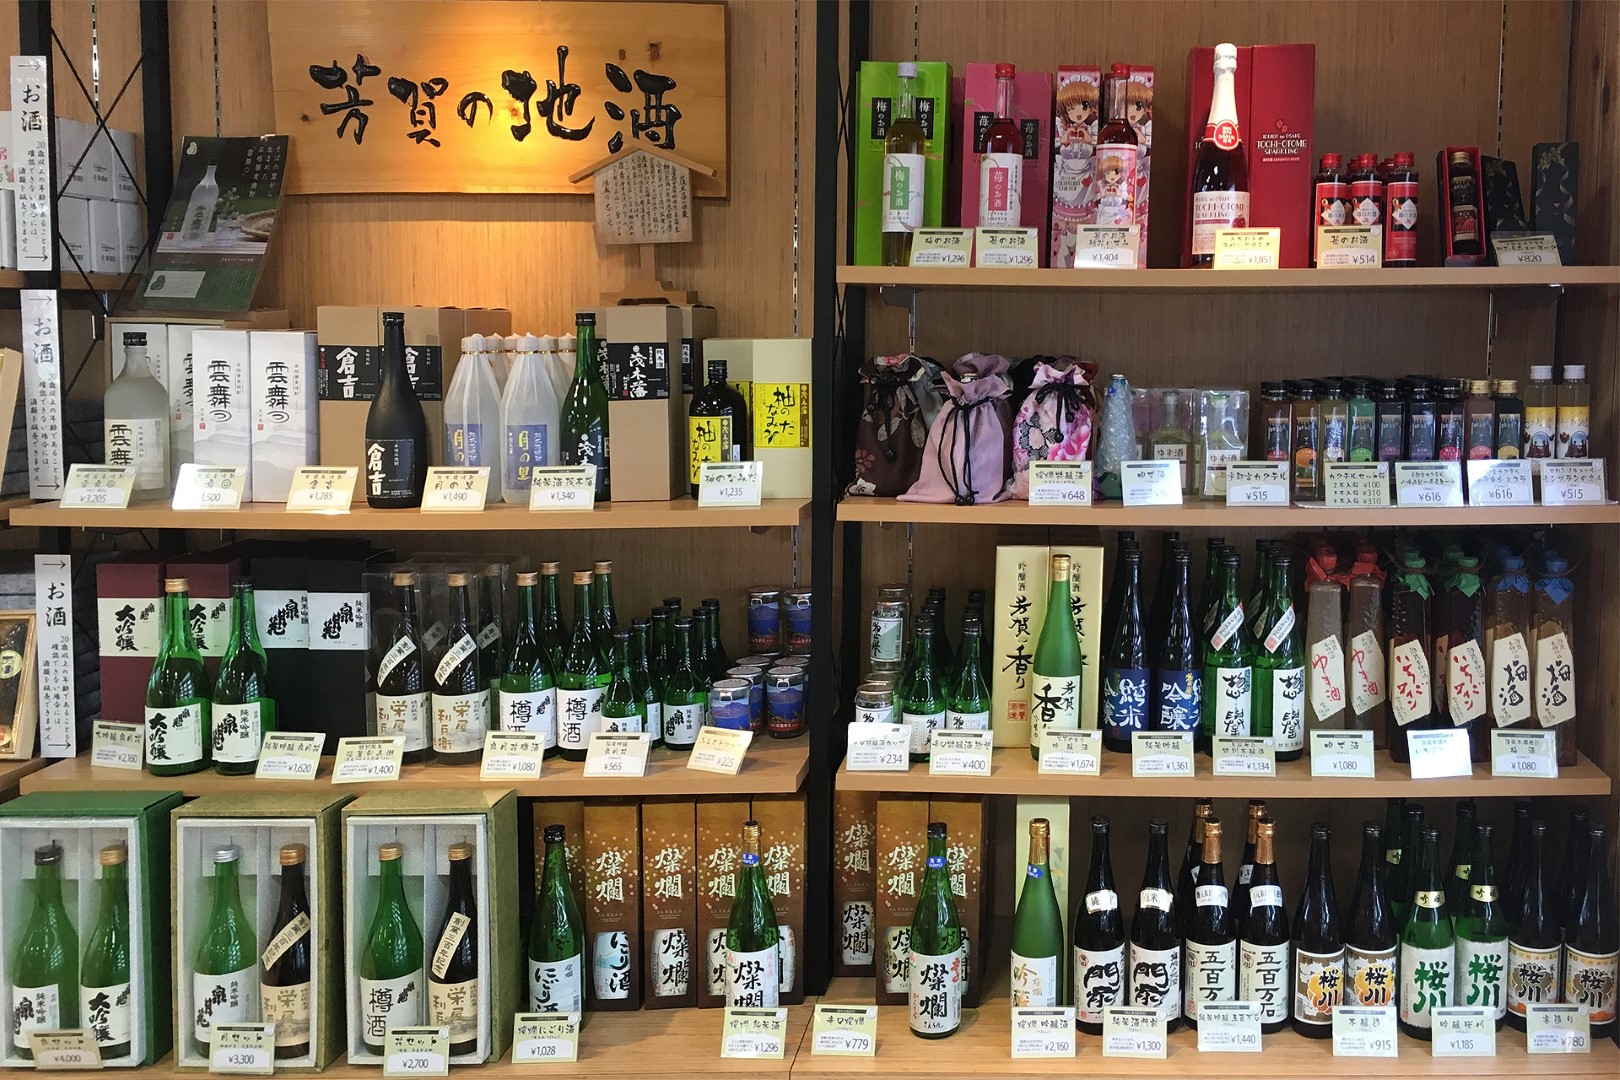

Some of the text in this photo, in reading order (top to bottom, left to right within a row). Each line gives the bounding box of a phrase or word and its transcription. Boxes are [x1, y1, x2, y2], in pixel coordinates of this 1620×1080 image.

[22, 84, 42, 132] お酒
[309, 45, 682, 155] 芳賀の地酒
[876, 99, 888, 136] 梅のお酒
[1024, 122, 1035, 157] 苺のお酒
[1256, 139, 1308, 149] TOCHI-OTOME
[894, 169, 906, 207] 梅のお酒
[993, 171, 1004, 207] 苺のお酒
[942, 254, 965, 263] ¥1,296
[1009, 255, 1034, 265] ¥1,296
[1092, 253, 1119, 262] ¥1,404
[1248, 254, 1273, 263] ¥1,851
[1352, 255, 1376, 264] ¥514
[1517, 255, 1542, 263] ¥820
[33, 318, 54, 364] お酒
[335, 346, 359, 399] 倉吉
[629, 351, 649, 399] 茂木藩
[1157, 448, 1185, 458] ゆず酒
[367, 442, 386, 496] 倉吉
[79, 494, 107, 504] ¥3,205
[308, 491, 333, 501] ¥1,285
[443, 491, 468, 501] ¥1,490
[551, 492, 575, 501] ¥1,340
[719, 486, 743, 497] ¥1,235
[1061, 490, 1085, 500] ¥648
[1245, 490, 1268, 501] ¥515
[1363, 481, 1381, 489] ¥100
[1418, 492, 1442, 502] ¥616
[1488, 488, 1513, 500] ¥616
[1560, 488, 1584, 499] ¥515
[1362, 497, 1381, 505] ¥310
[1017, 562, 1027, 592] 吟醸酒
[46, 582, 67, 627] お酒
[300, 595, 309, 625] 純米吟醸
[355, 599, 364, 629] 純米吟醸
[115, 604, 139, 652] 大吟醸
[1002, 596, 1033, 690] 芳賀の香り
[1312, 654, 1342, 702] ゆず酒
[1350, 648, 1379, 697] ゆず酒
[1498, 660, 1528, 707] 梅酒
[1542, 659, 1572, 707] 梅酒
[390, 700, 408, 732] 栄屋
[452, 700, 471, 733] 栄屋
[1116, 678, 1147, 730] 純米
[1160, 682, 1193, 730] 吟醸
[239, 708, 250, 739] 純米吟醸
[437, 708, 452, 751] 利兵衛
[562, 697, 589, 743] 樽酒
[149, 712, 172, 761] 大吟醸
[117, 753, 138, 764] ¥2,160
[288, 762, 312, 773] ¥1,620
[367, 765, 395, 775] ¥1,400
[512, 761, 536, 772] ¥1,080
[604, 761, 622, 771] ¥565
[717, 757, 735, 768] ¥225
[880, 753, 904, 764] ¥234
[962, 759, 986, 770] ¥400
[1071, 758, 1095, 770] ¥1,674
[1165, 761, 1188, 771] ¥1,361
[1246, 763, 1270, 771] ¥1,134
[1332, 760, 1358, 771] ¥1,080
[1511, 761, 1537, 771] ¥1,080
[844, 823, 872, 874] 燦爛
[595, 850, 625, 902] 燦爛
[654, 846, 684, 898] 燦爛
[708, 846, 737, 898] 燦爛
[887, 844, 916, 898] 燦爛
[843, 904, 871, 955] 燦爛
[229, 980, 239, 1008] 純米吟醸
[919, 963, 949, 1021] 燦爛
[1254, 950, 1282, 1018] 五百万石
[1318, 970, 1339, 1007] 桜川
[1364, 966, 1389, 1004] 桜川
[1413, 960, 1451, 1016] 桜川
[1466, 953, 1504, 1009] 桜川
[1517, 963, 1546, 1003] 桜川
[1579, 969, 1609, 1008] 桜川
[36, 992, 47, 1024] 純米吟醸
[88, 991, 115, 1042] 大吟醸
[277, 989, 298, 1023] 栄屋
[366, 987, 395, 1037] 樽酒
[447, 986, 467, 1021] 栄屋
[530, 1045, 556, 1056] ¥1,028
[754, 1042, 779, 1053] ¥1,296
[844, 1038, 869, 1050] ¥779
[1044, 1041, 1069, 1052] ¥2,160
[1136, 1040, 1162, 1051] ¥1,300
[1231, 1034, 1256, 1045] ¥1,440
[1368, 1038, 1391, 1051] ¥915
[1450, 1039, 1474, 1050] ¥1,185
[1560, 1036, 1585, 1047] ¥780
[54, 1054, 82, 1062] ¥4,000
[228, 1054, 255, 1065] ¥3,300
[402, 1058, 429, 1069] ¥2,700
